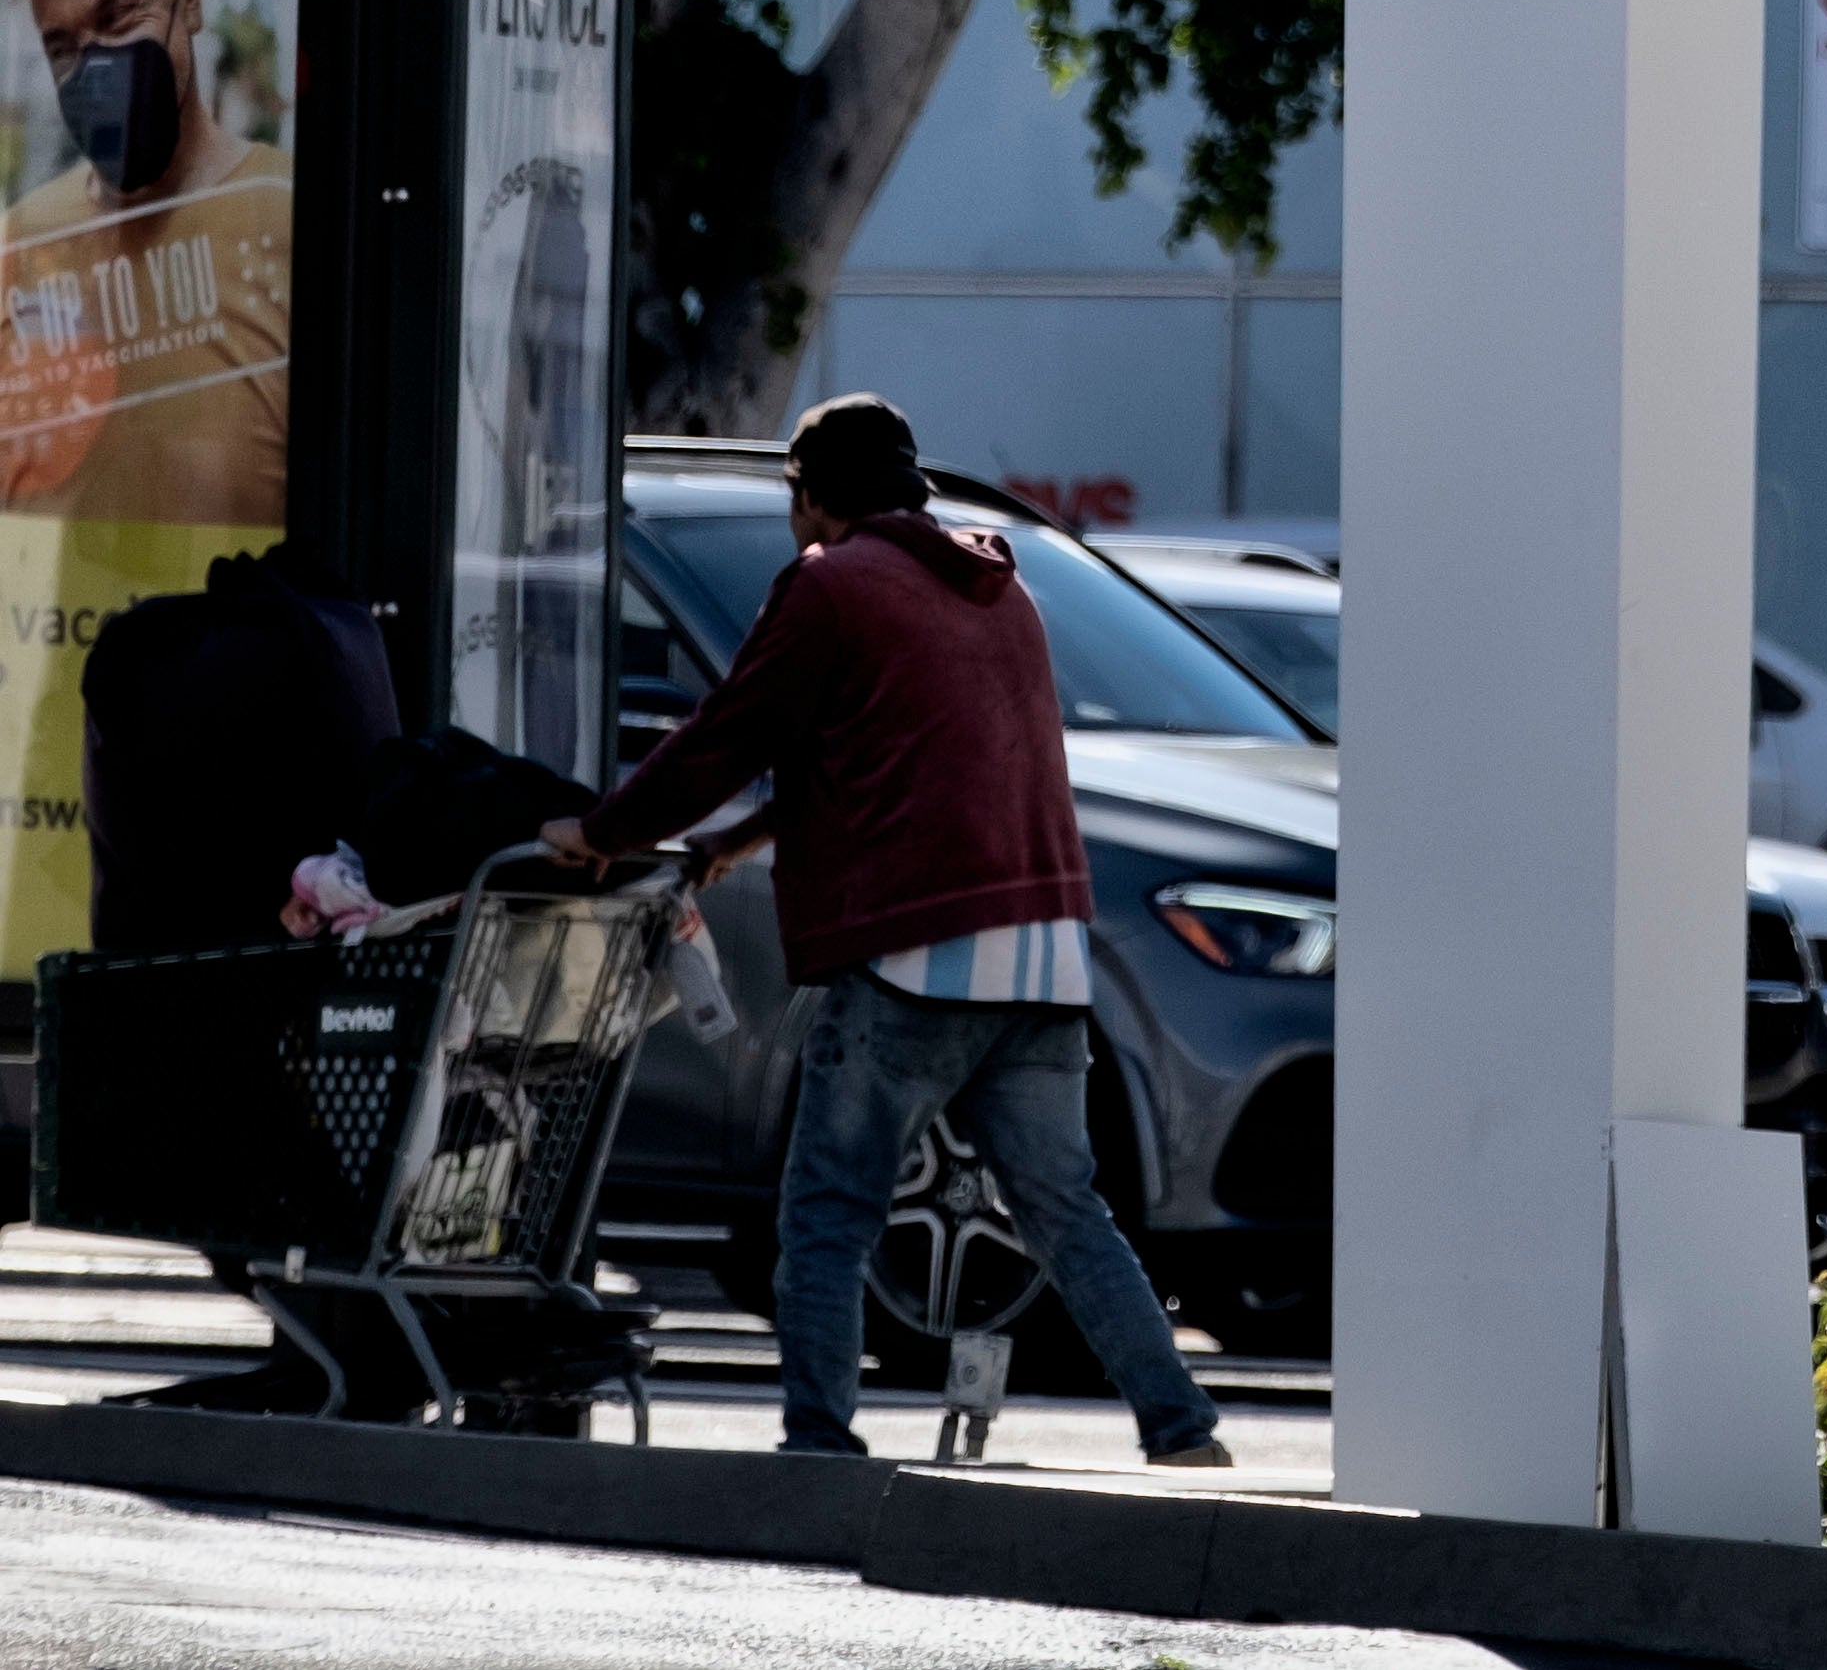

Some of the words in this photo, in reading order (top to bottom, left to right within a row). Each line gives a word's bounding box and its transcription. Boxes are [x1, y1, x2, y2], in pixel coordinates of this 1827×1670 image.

[37, 270, 82, 356] UP
[91, 255, 140, 342] TO
[145, 234, 218, 328] YOU
[79, 319, 225, 368] VACCINATION
